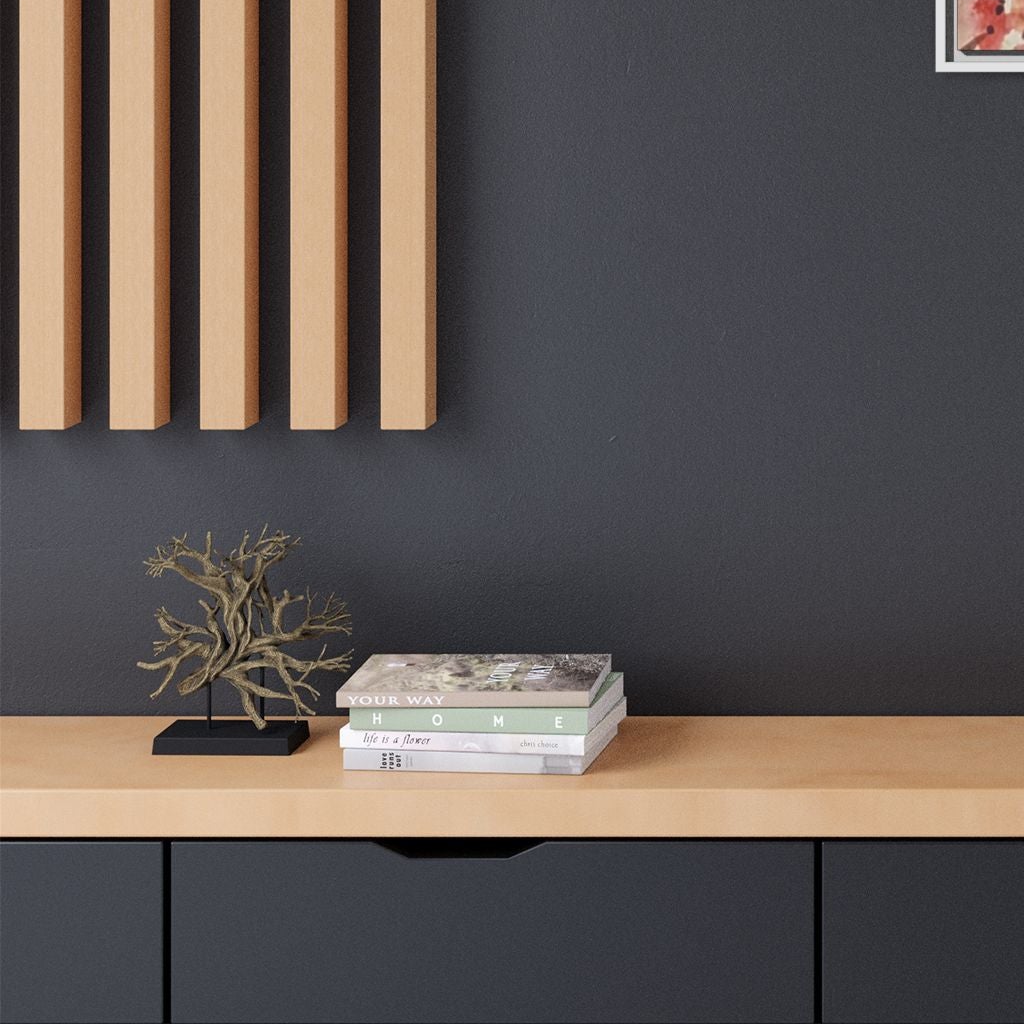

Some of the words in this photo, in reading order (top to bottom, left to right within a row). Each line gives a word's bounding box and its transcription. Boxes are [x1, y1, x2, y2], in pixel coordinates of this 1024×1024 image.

[348, 695, 400, 705] YOUR
[406, 695, 445, 705] WAY
[363, 732, 379, 747] life
[381, 734, 390, 744] is
[400, 734, 431, 748] flower
[520, 739, 536, 748] chris
[537, 740, 559, 749] choice
[380, 753, 388, 769] love
